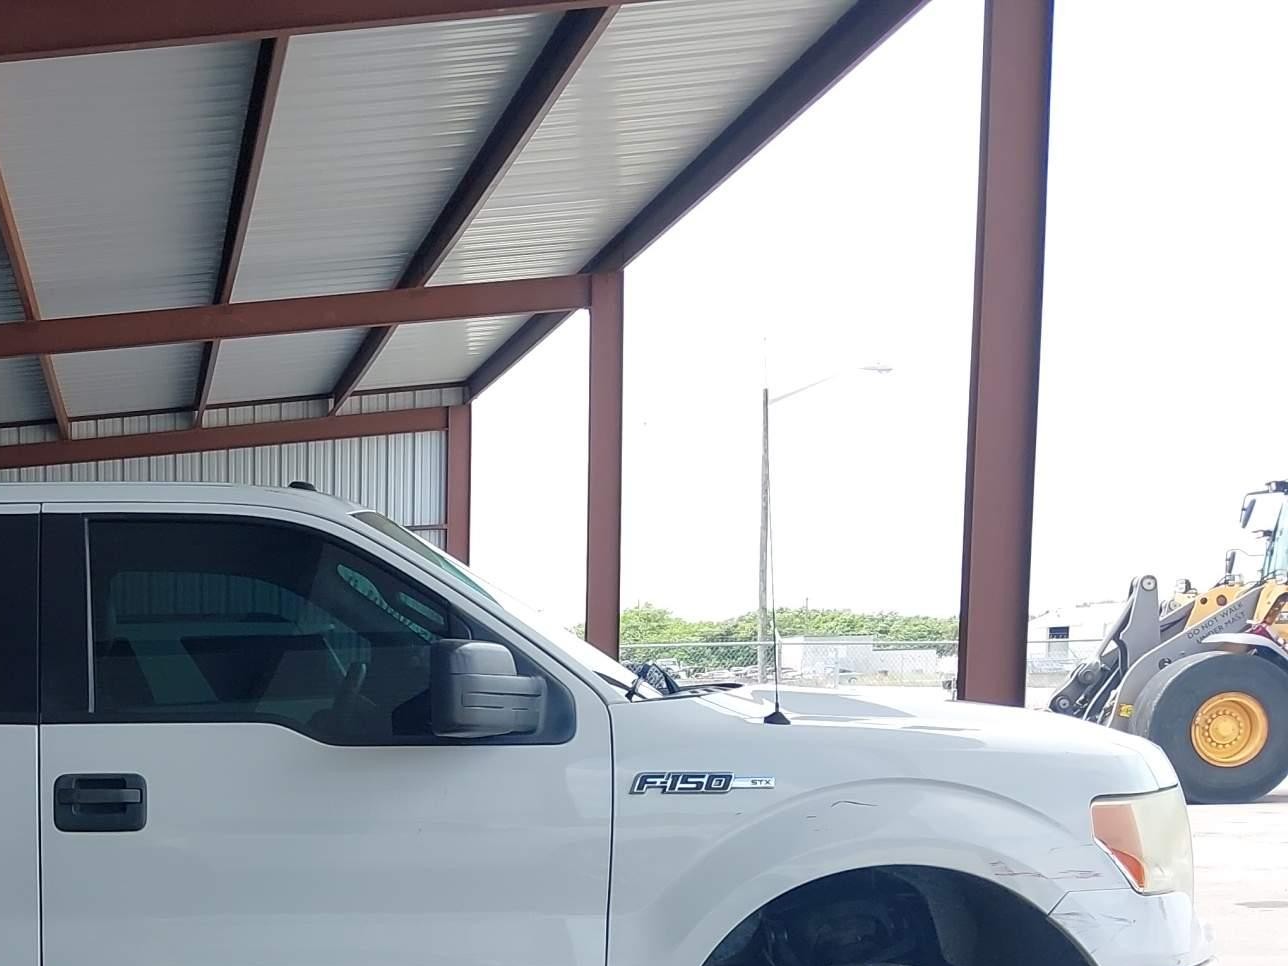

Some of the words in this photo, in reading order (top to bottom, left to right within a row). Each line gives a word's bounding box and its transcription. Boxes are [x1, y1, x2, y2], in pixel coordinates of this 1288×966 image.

[1187, 628, 1200, 639] DO
[1201, 616, 1218, 631] NOT
[1220, 604, 1243, 618] WALK
[629, 771, 734, 795] F-150
